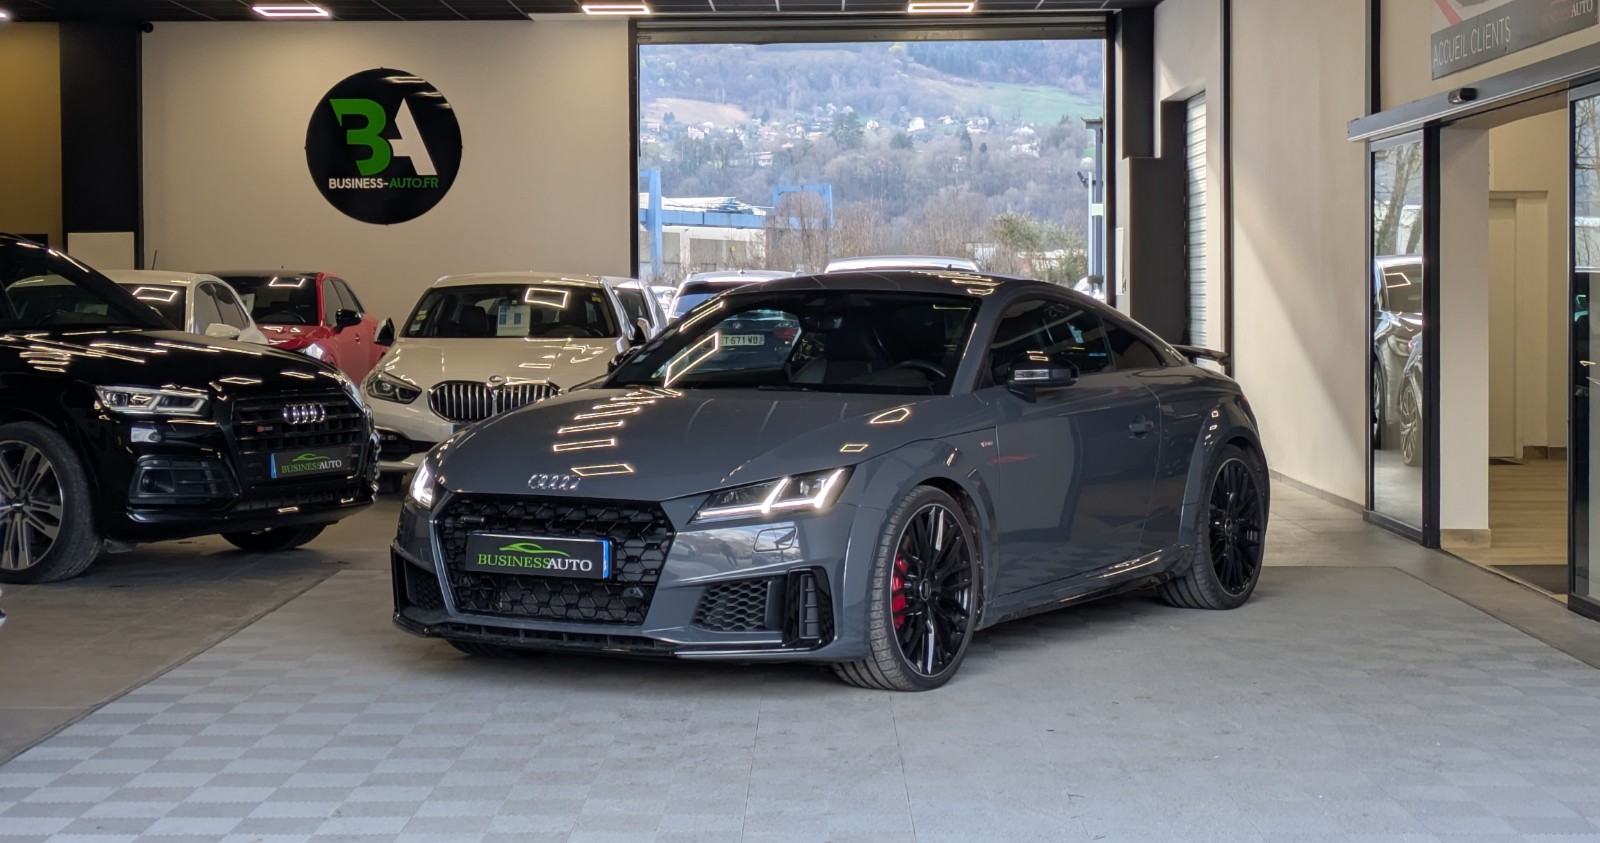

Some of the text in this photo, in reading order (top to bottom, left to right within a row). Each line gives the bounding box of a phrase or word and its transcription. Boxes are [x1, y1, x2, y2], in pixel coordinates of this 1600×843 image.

[1433, 31, 1468, 68] ACCUEIL
[1470, 16, 1512, 54] CLIENTS
[328, 177, 439, 189] BUSINESS-AUTO.FR
